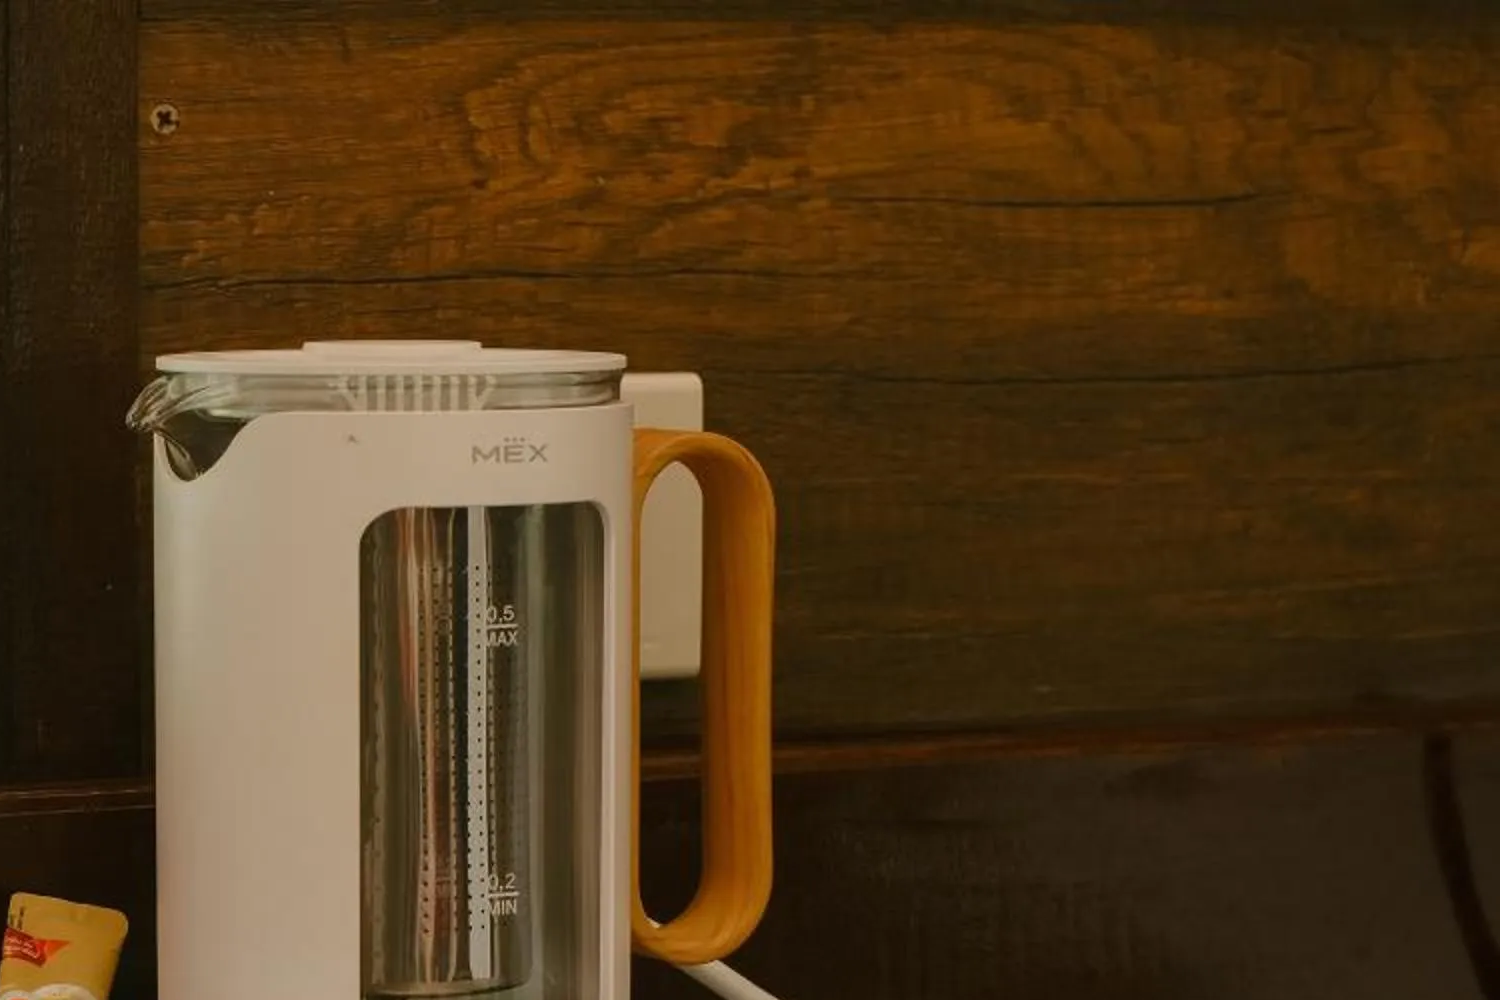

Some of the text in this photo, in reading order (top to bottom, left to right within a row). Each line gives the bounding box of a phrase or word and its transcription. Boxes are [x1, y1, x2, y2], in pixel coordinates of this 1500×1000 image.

[487, 604, 515, 622] 0.5
[487, 630, 519, 646] MAX
[488, 872, 517, 891] 0.2
[489, 899, 518, 917] MIN
